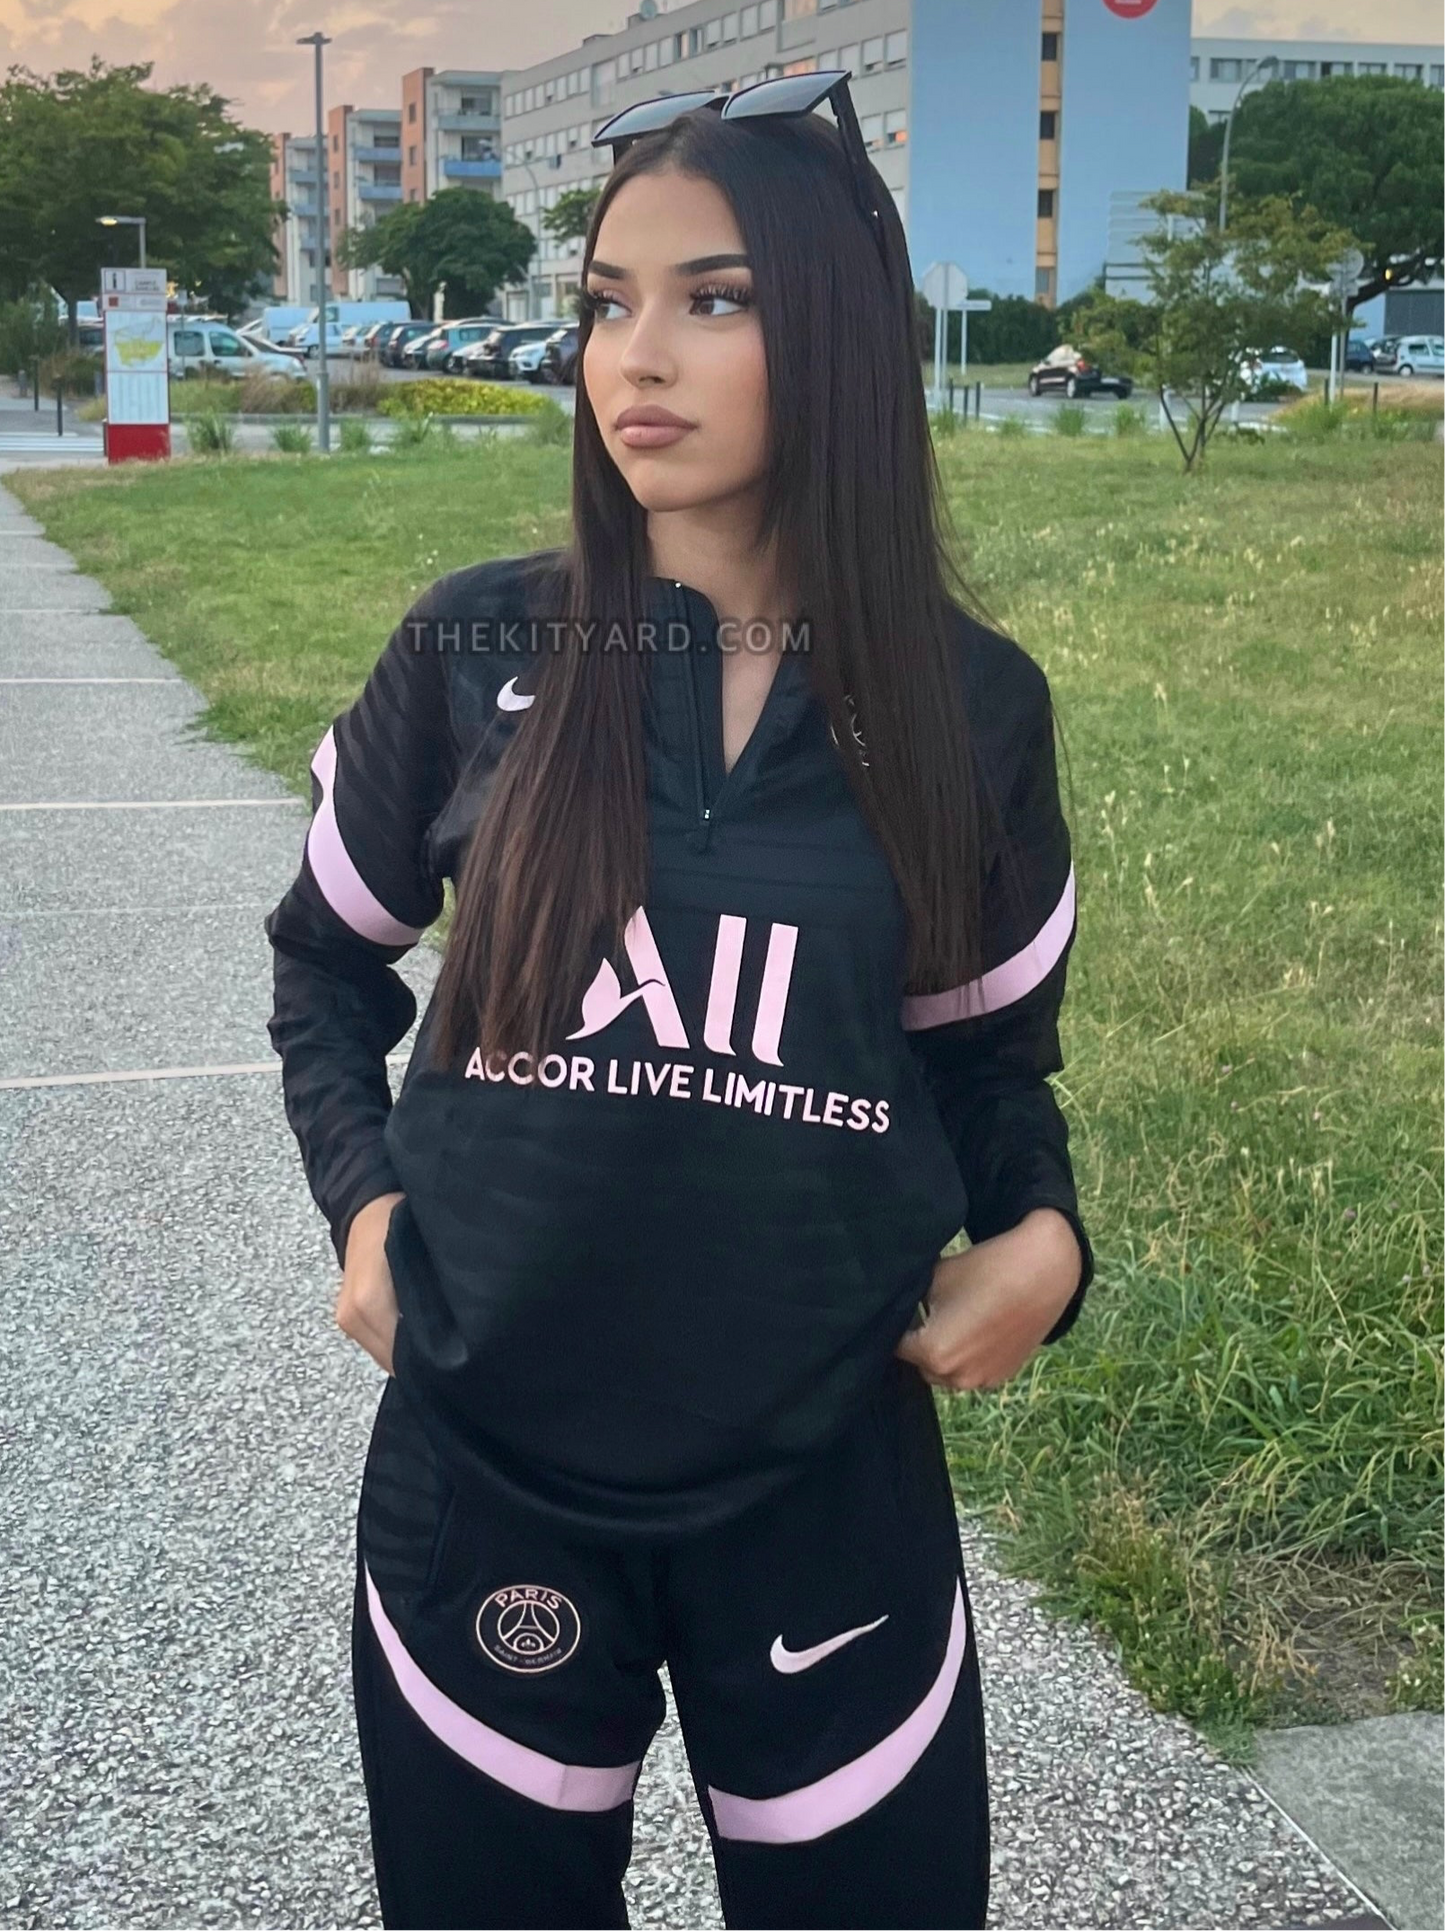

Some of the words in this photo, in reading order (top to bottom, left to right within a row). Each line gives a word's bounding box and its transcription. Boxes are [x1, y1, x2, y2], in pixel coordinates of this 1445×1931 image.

[464, 1046, 595, 1092] ACCOR
[607, 1059, 694, 1098] LIVE
[702, 1068, 890, 1134] LIMITLESS
[495, 1588, 562, 1609] PARIS
